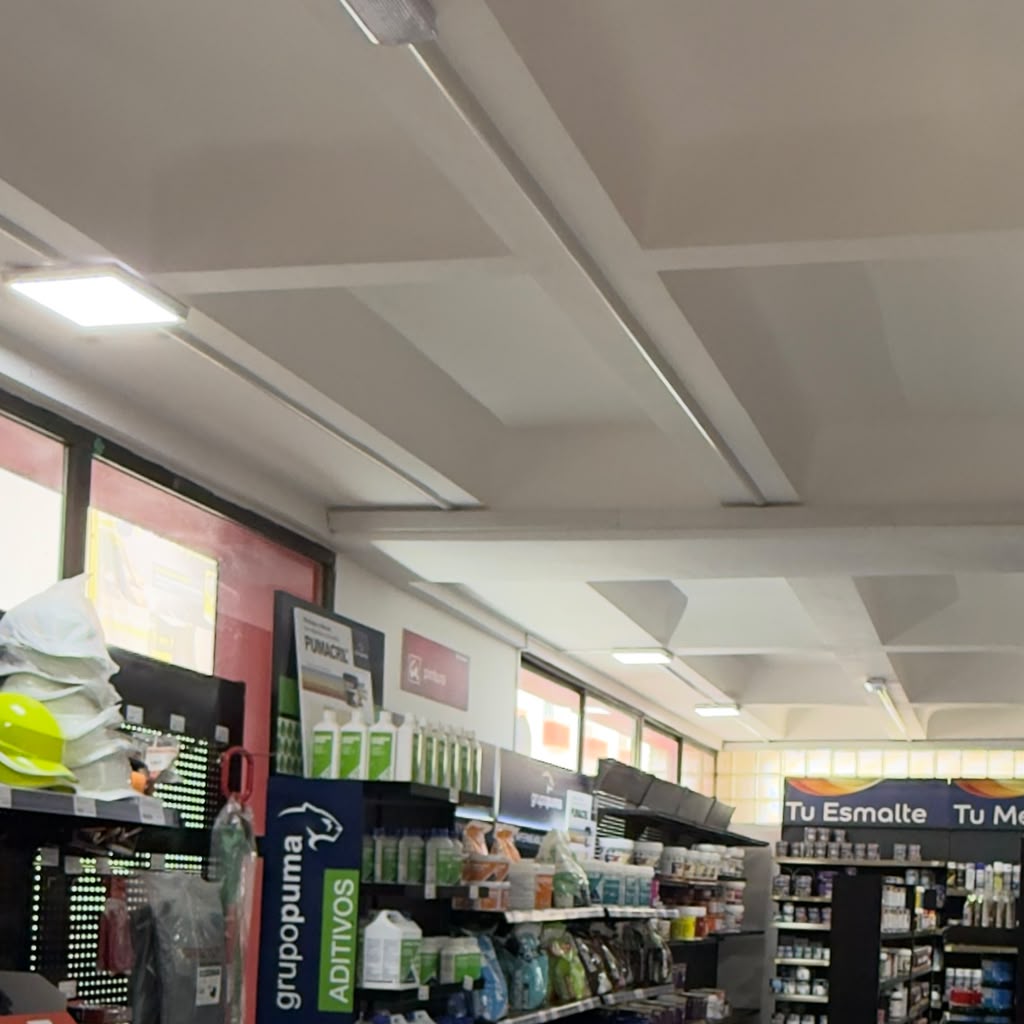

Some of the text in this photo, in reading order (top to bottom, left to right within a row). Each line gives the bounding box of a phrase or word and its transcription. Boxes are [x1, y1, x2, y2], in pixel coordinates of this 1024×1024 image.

[786, 801, 927, 824] Tu Esmalte
[953, 804, 985, 825] Tu
[276, 834, 305, 1011] grupopuma
[329, 878, 355, 1004] ADITIVOS
